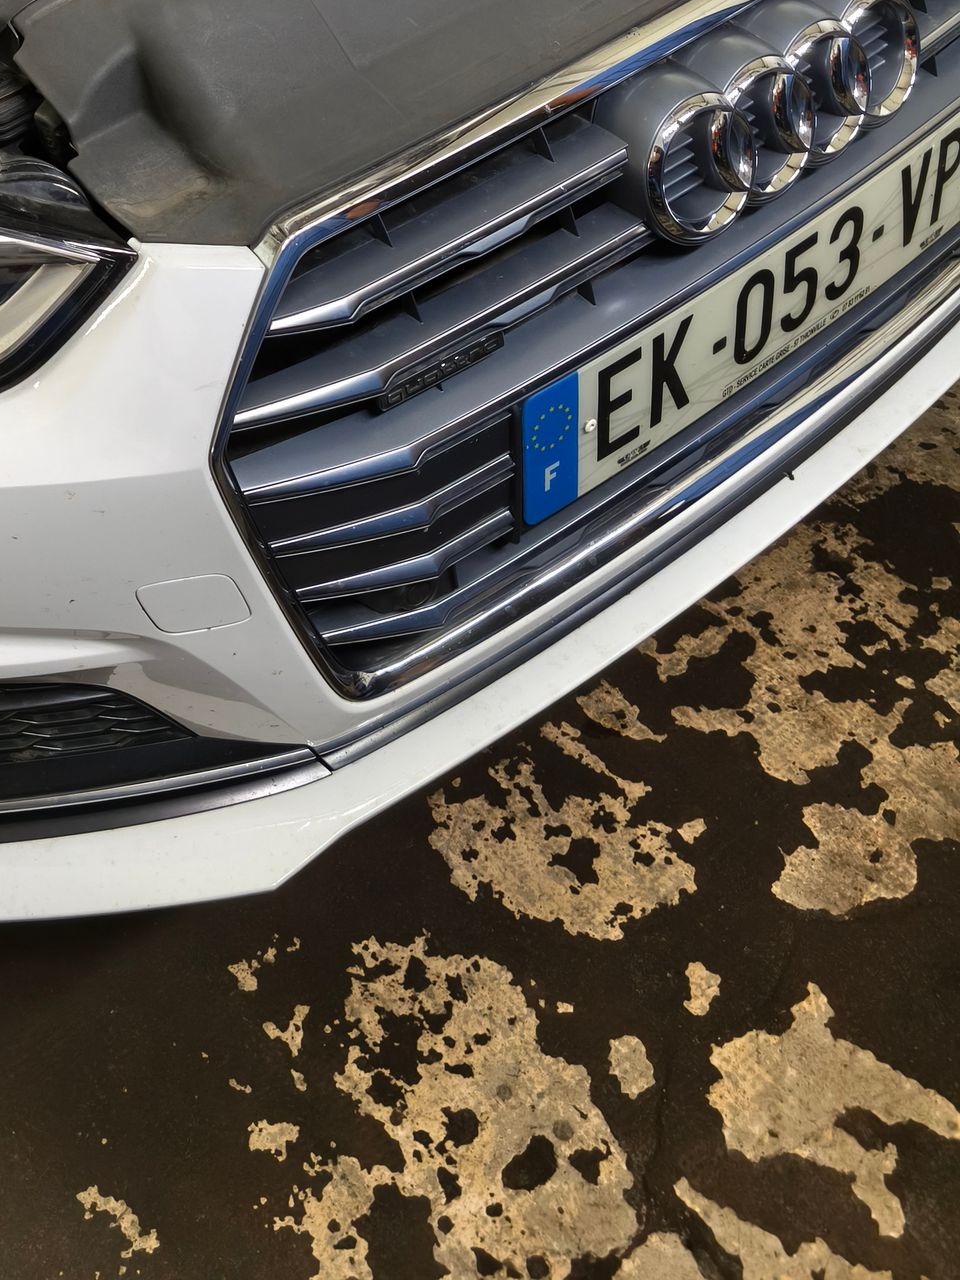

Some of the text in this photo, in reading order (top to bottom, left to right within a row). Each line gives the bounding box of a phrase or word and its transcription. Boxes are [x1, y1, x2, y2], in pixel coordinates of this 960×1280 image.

[597, 128, 960, 462] EK-053-VP
[736, 367, 758, 387] SERVICE
[759, 355, 775, 372] CARTE
[775, 344, 791, 360] GRISE
[545, 460, 560, 492] F
